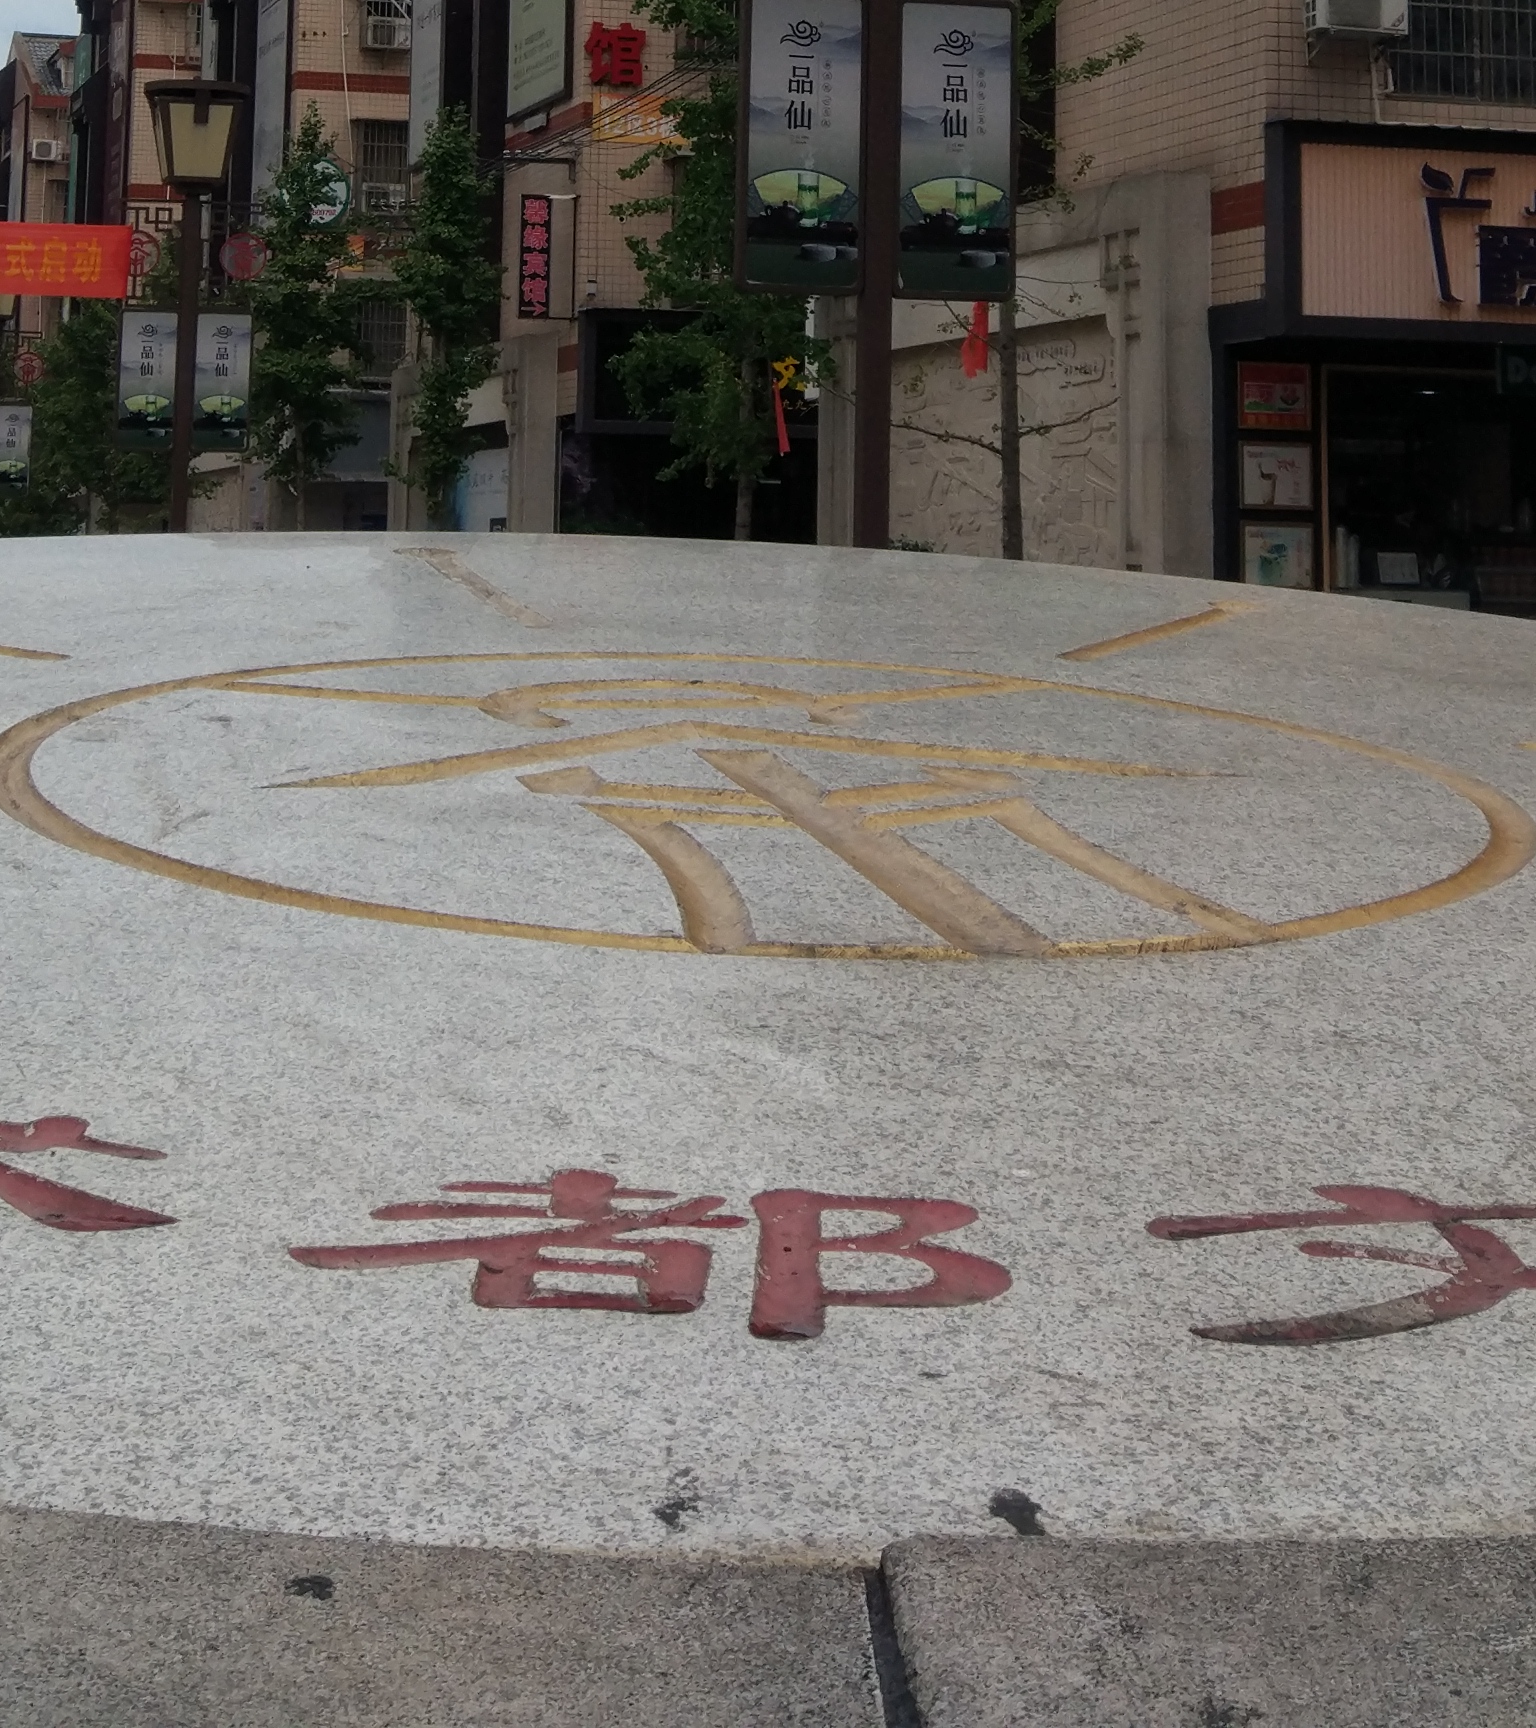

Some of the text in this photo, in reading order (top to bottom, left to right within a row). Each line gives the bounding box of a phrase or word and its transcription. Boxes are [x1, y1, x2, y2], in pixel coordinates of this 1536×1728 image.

[784, 54, 815, 131] 一品仙
[939, 63, 969, 139] 一品仙
[522, 198, 549, 303] 馨缘宾馆
